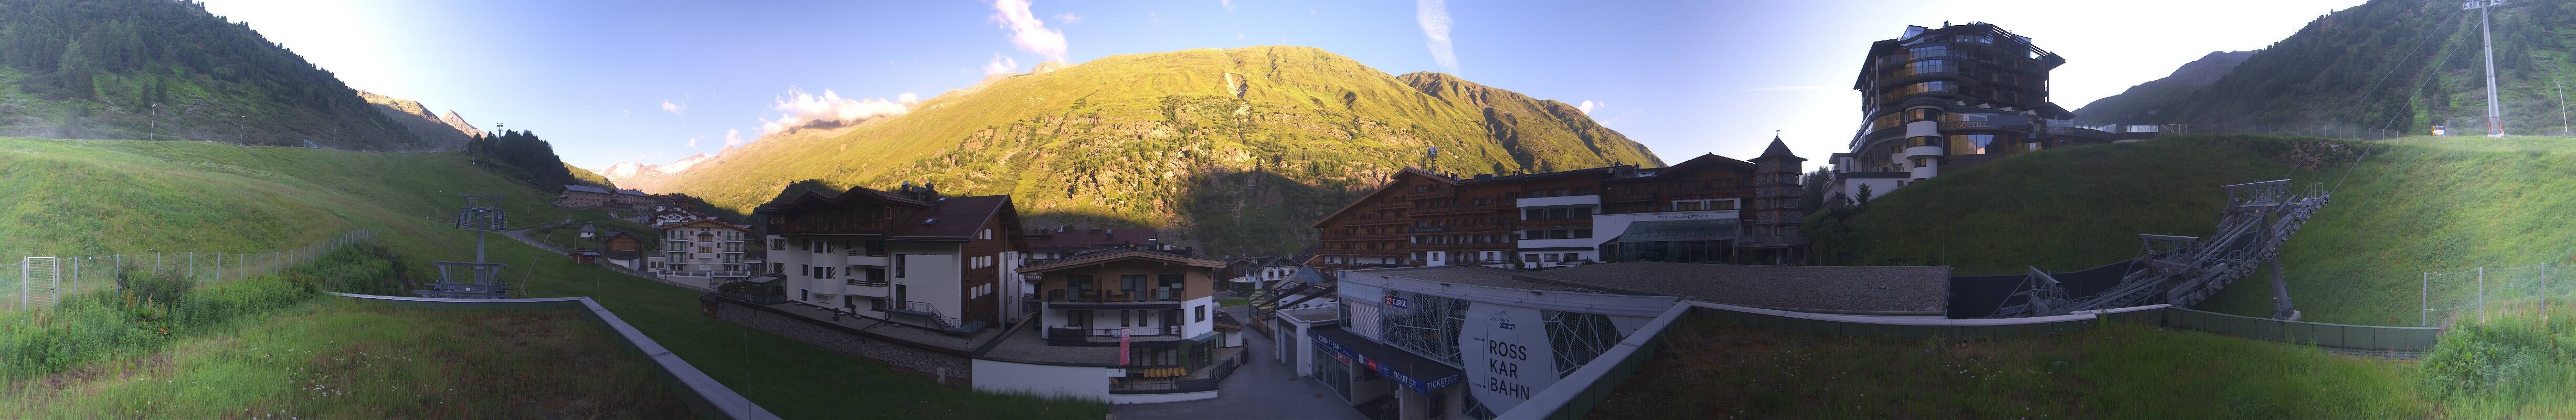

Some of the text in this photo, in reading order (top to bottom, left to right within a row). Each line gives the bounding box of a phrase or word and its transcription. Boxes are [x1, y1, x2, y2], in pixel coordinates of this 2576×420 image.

[1393, 299, 1407, 307] GURGL
[1490, 340, 1526, 361] ROSS
[1393, 371, 1408, 383] TICKET
[1490, 358, 1518, 379] KAR
[1427, 376, 1448, 390] TICKET
[1491, 377, 1530, 400] BAHN
